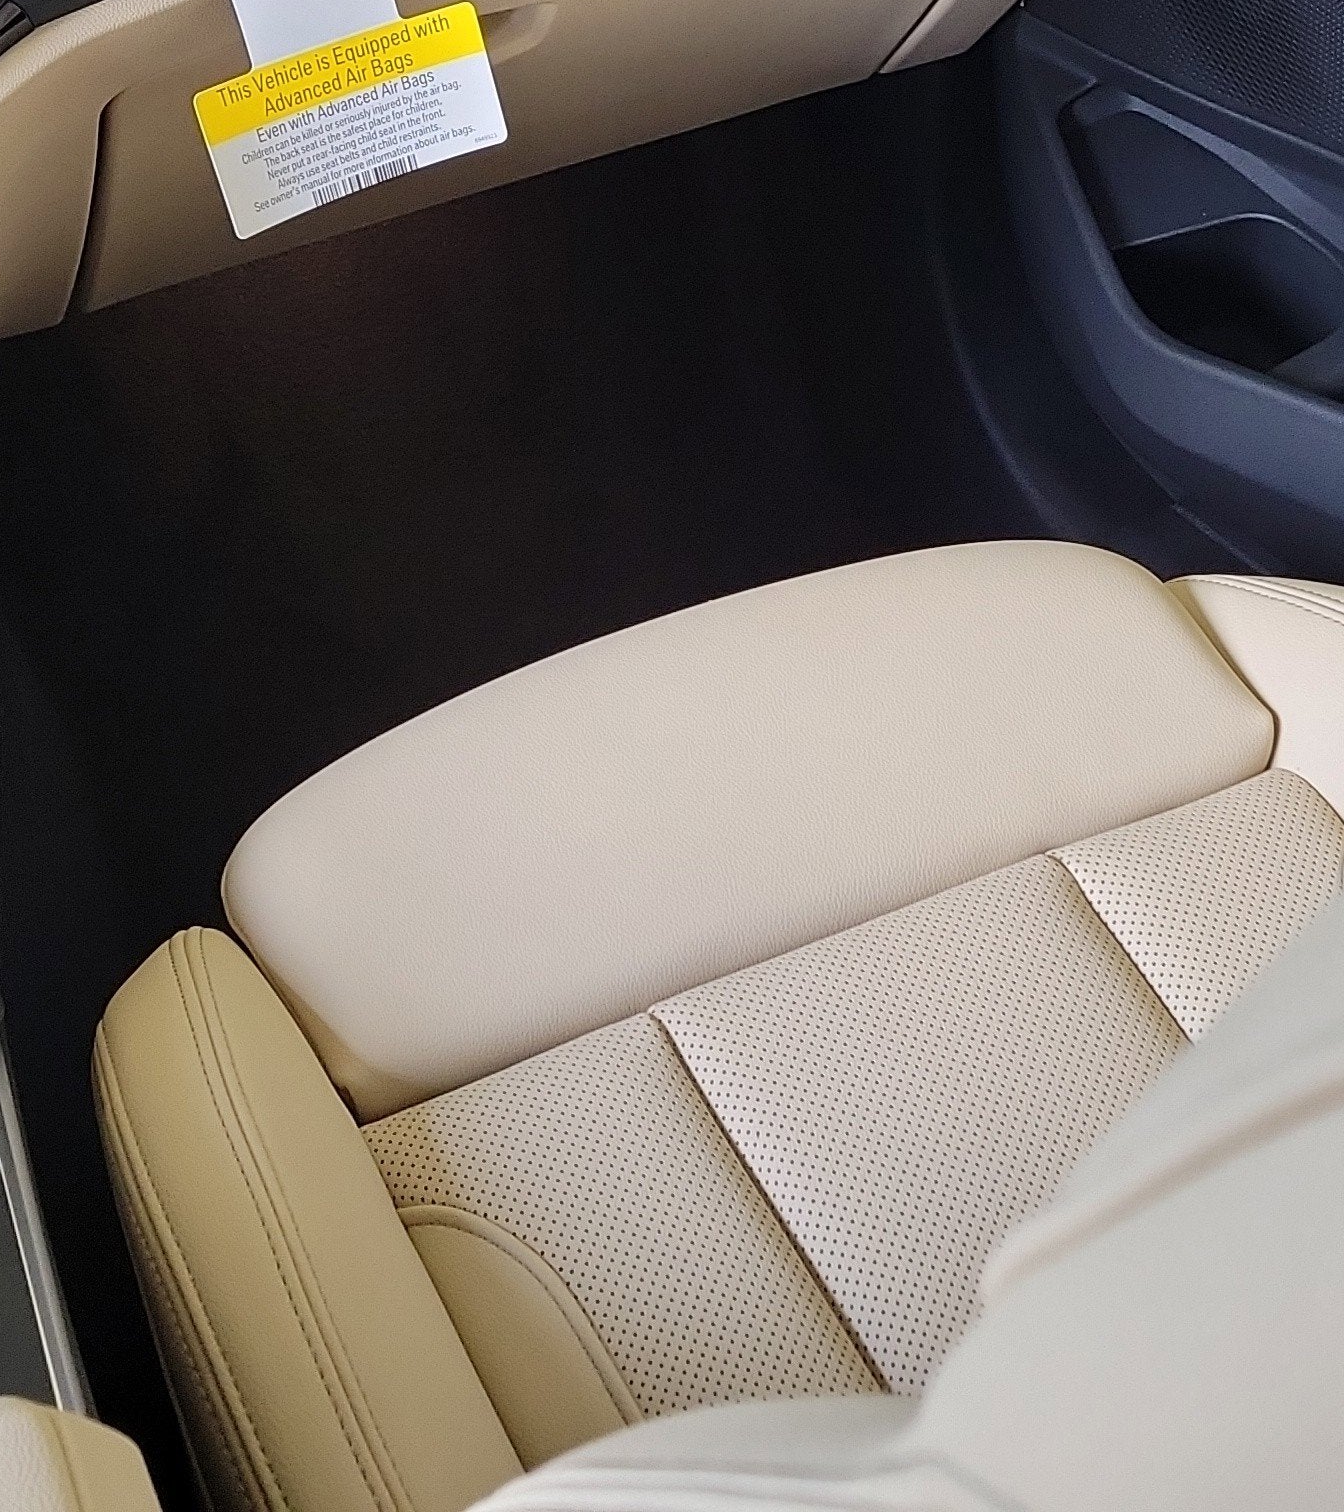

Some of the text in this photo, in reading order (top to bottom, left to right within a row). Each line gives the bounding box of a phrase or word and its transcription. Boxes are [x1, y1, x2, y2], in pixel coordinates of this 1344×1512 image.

[215, 13, 450, 107] This Vehicle is Equipped with
[265, 52, 413, 117] Advanced Air Bags
[241, 145, 274, 164] Children
[274, 139, 290, 151] can
[300, 124, 324, 141] killed
[334, 108, 371, 129] seriously
[371, 96, 401, 115] injured
[413, 89, 428, 101] the
[429, 84, 440, 95] air
[440, 80, 461, 91] bag.
[255, 70, 434, 143] Even with Advanced Air Bags
[262, 156, 280, 168] The
[279, 146, 301, 162] back
[300, 139, 319, 154] seat
[326, 132, 341, 143] the
[341, 121, 368, 138] safest
[367, 114, 391, 131] place
[391, 110, 404, 120] for
[404, 98, 442, 115] children.
[253, 124, 476, 212] See owner's manual for more information about air bags.
[266, 164, 290, 180] Never
[290, 157, 306, 172] put
[311, 139, 357, 162] rear-facing
[356, 129, 378, 145] child
[377, 123, 397, 138] seat
[406, 116, 421, 127] the
[421, 108, 445, 123] front.
[277, 122, 441, 189] Always use seat belts and child restraints.
